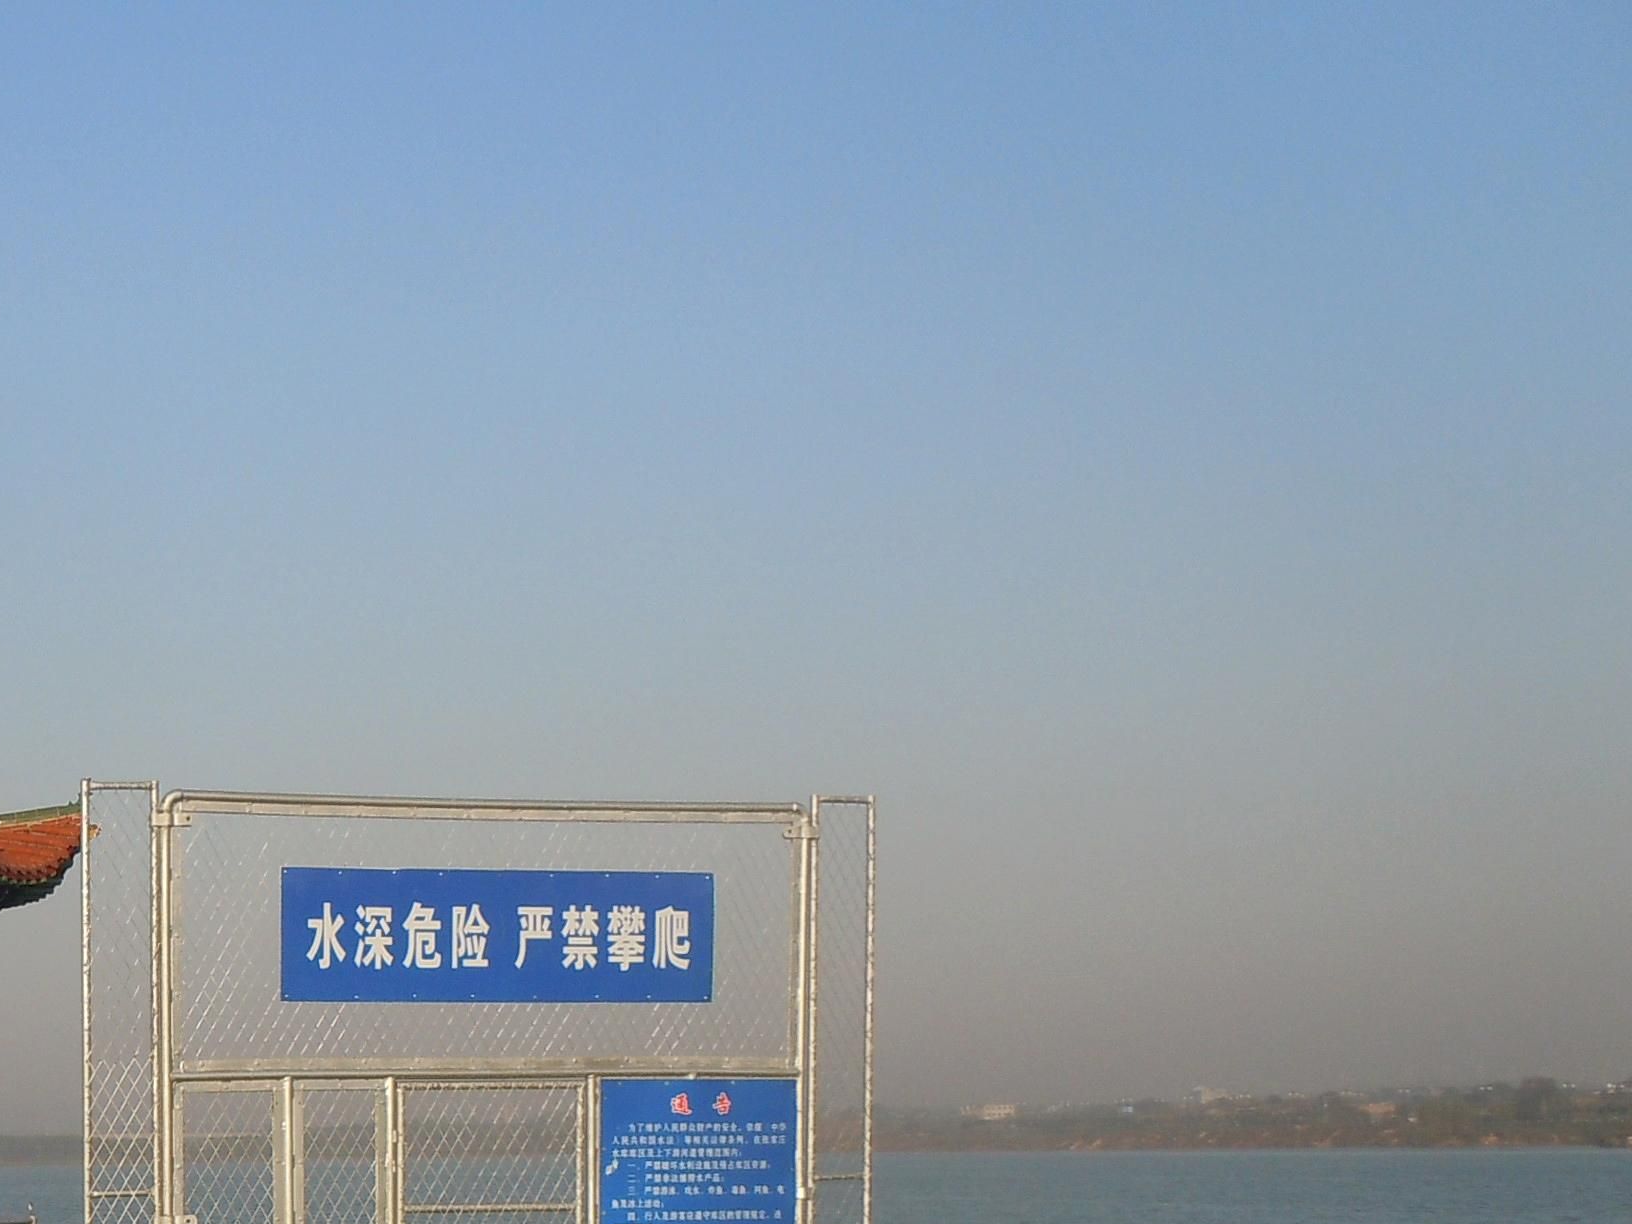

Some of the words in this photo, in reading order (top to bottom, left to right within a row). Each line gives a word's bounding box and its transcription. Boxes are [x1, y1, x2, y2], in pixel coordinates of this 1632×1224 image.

[306, 902, 490, 970] 水深危险
[514, 904, 691, 971] 严禁攀爬
[670, 1092, 733, 1116] 通告
